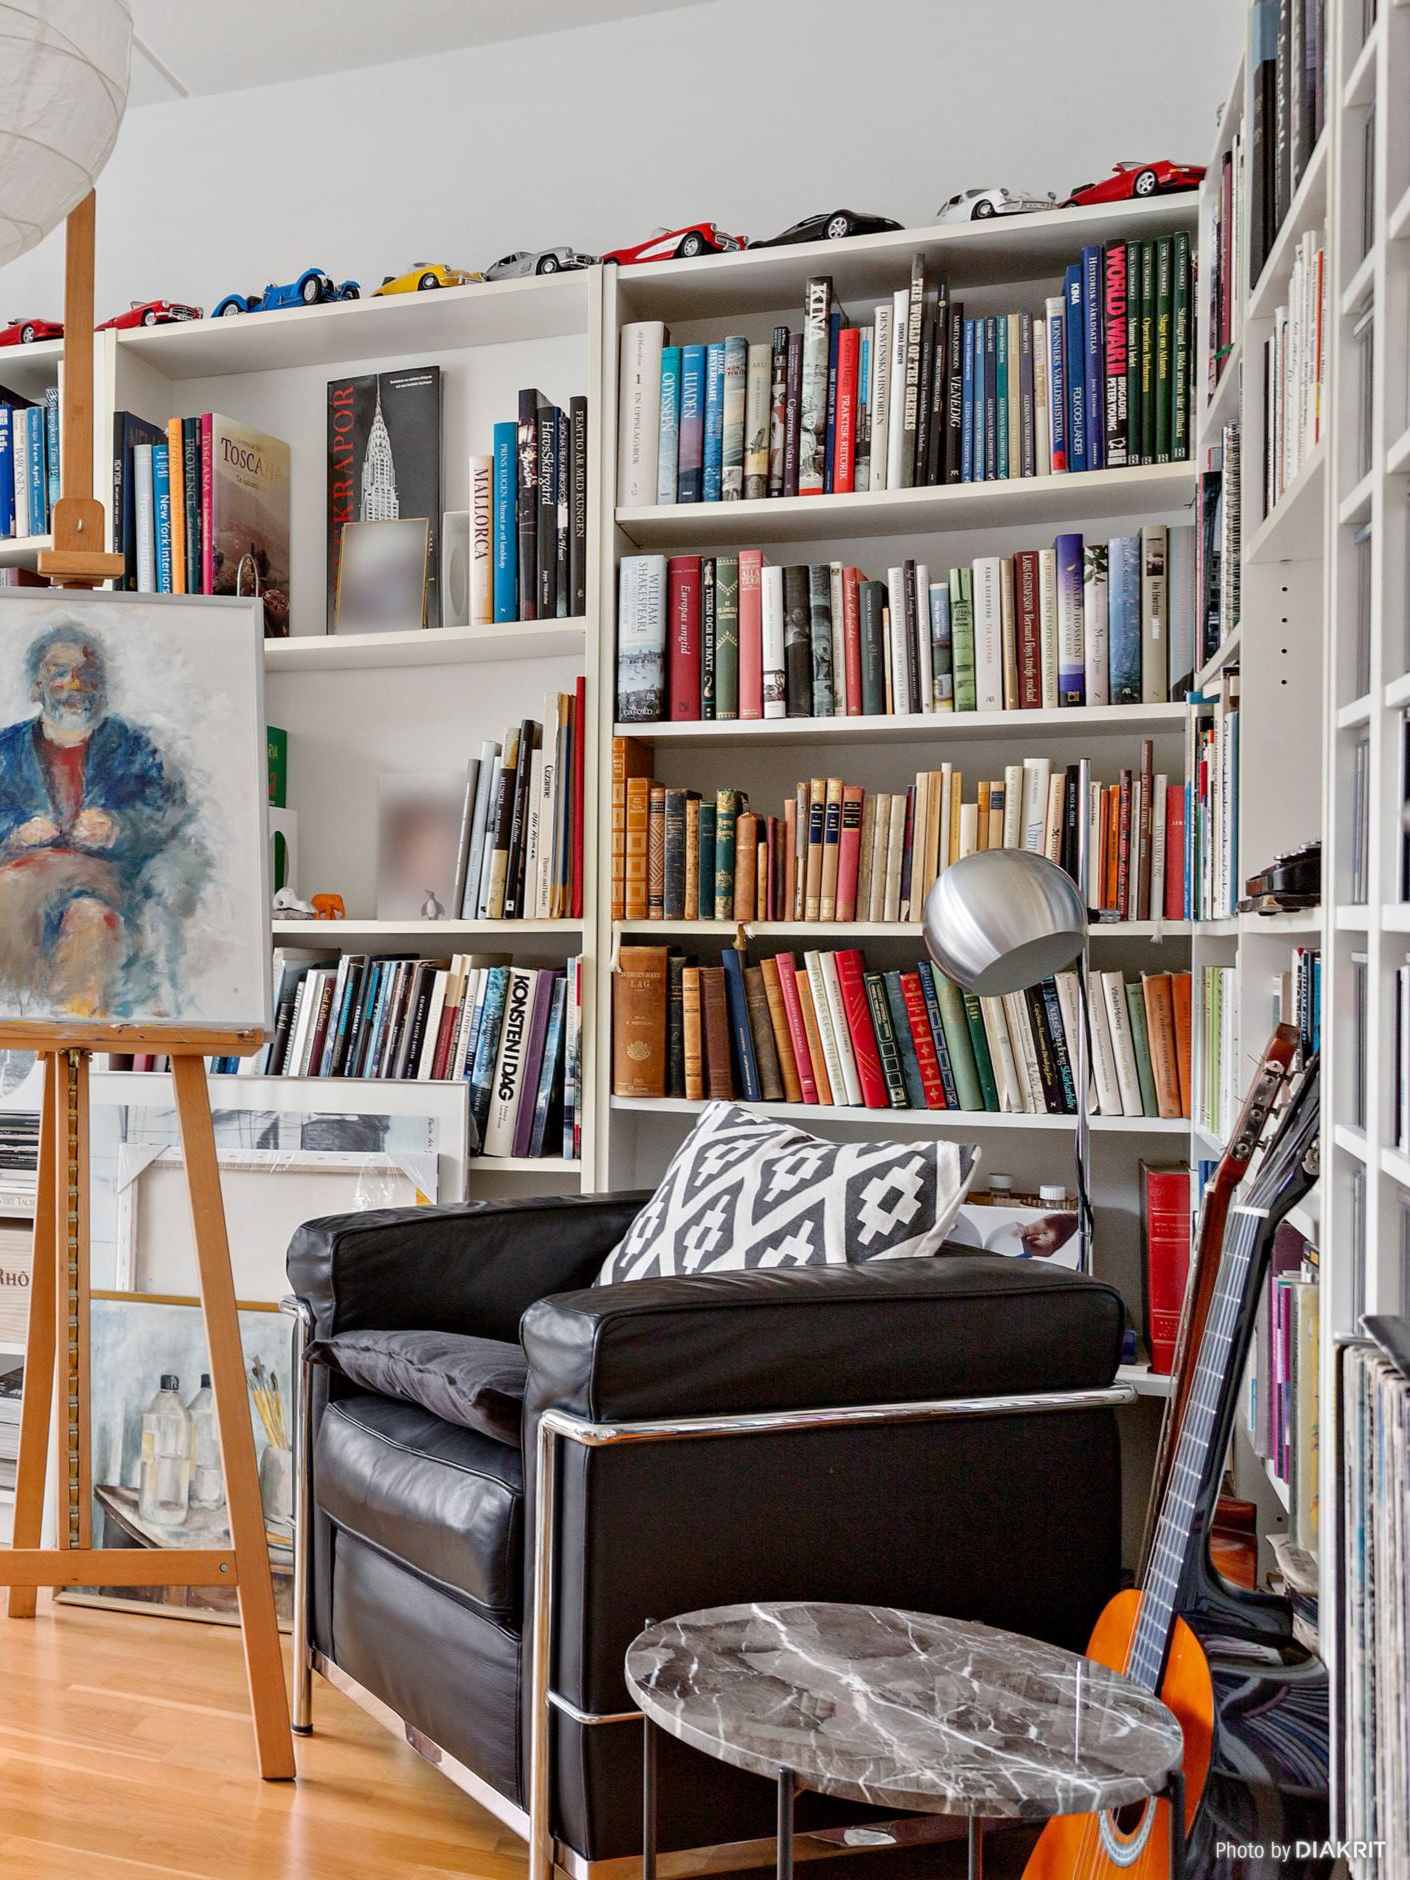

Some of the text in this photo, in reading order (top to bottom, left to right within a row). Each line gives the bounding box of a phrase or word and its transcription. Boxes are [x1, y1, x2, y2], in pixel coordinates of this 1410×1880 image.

[809, 282, 827, 344] KINA
[1070, 282, 1080, 305] KINA
[1088, 256, 1099, 354] HISTORISK VÄRLDSATLAS
[1106, 246, 1127, 375] WORLD WAR II
[1128, 317, 1137, 368] Mannen ledet
[1142, 317, 1152, 352] Operation
[1159, 314, 1168, 379] Slaget Atlanten
[1176, 308, 1186, 345] Stalingrad
[709, 350, 718, 403] HEYERDAHL
[876, 311, 888, 425] DEN SVENSKA HISTORIEN
[904, 278, 924, 430] THE WORLD OF THE GREEKS
[1176, 352, 1186, 370] Röda
[662, 372, 675, 432] ODYSSEEN
[684, 372, 698, 418] ILIADEN
[950, 376, 961, 428] VENEDIG
[1052, 320, 1065, 443] BONNIERS VÄRLDSHISTORIA
[1073, 387, 1082, 406] FOLK
[1107, 378, 1118, 432] PETER YOUNG
[1118, 376, 1127, 421] BRIGADIER
[558, 422, 568, 448] SKÖNA
[786, 398, 798, 443] Cigarrernas
[840, 395, 850, 480] PRAKTISK RETORIK
[1074, 406, 1082, 424] OCH
[1176, 410, 1185, 438] tillbaka
[185, 438, 196, 507] PROVENCE
[202, 432, 211, 491] TOSCANA
[538, 421, 555, 506] HavsSkärgård
[576, 410, 586, 538] FEMTIO ÅR MED KUNGEN
[474, 468, 490, 561] MALLORCA
[498, 443, 509, 569] PRINS EUGEN Minnet landskap
[160, 494, 172, 594] New York Interiors
[1022, 555, 1034, 573] LARS
[637, 562, 647, 633] SHAKESPEARE
[648, 573, 659, 625] WILLIAM
[1022, 572, 1035, 611] GUSTAFSSON
[1073, 572, 1082, 659] KHALED HOSSEINI
[678, 585, 691, 655] Europas ungtid
[706, 588, 714, 672] TUSEN OCH EN NATT
[1024, 614, 1035, 641] Bernard
[1024, 658, 1036, 677] tredje
[1026, 678, 1037, 702] rockad
[623, 708, 653, 716] OXFORD
[498, 776, 506, 804] MUNCH
[544, 764, 554, 799] Cézanne
[316, 987, 332, 1032] Carl Kylberg
[352, 1005, 362, 1035] CHAGALL
[410, 995, 426, 1059] EDWARD LUCIE-SMITH
[504, 975, 531, 1054] KONSTEN
[1110, 986, 1123, 1030] Vilhelm Moberg
[498, 1062, 518, 1102] DAG
[1049, 1004, 1075, 1110] August Strindberg Skärkarlsliv
